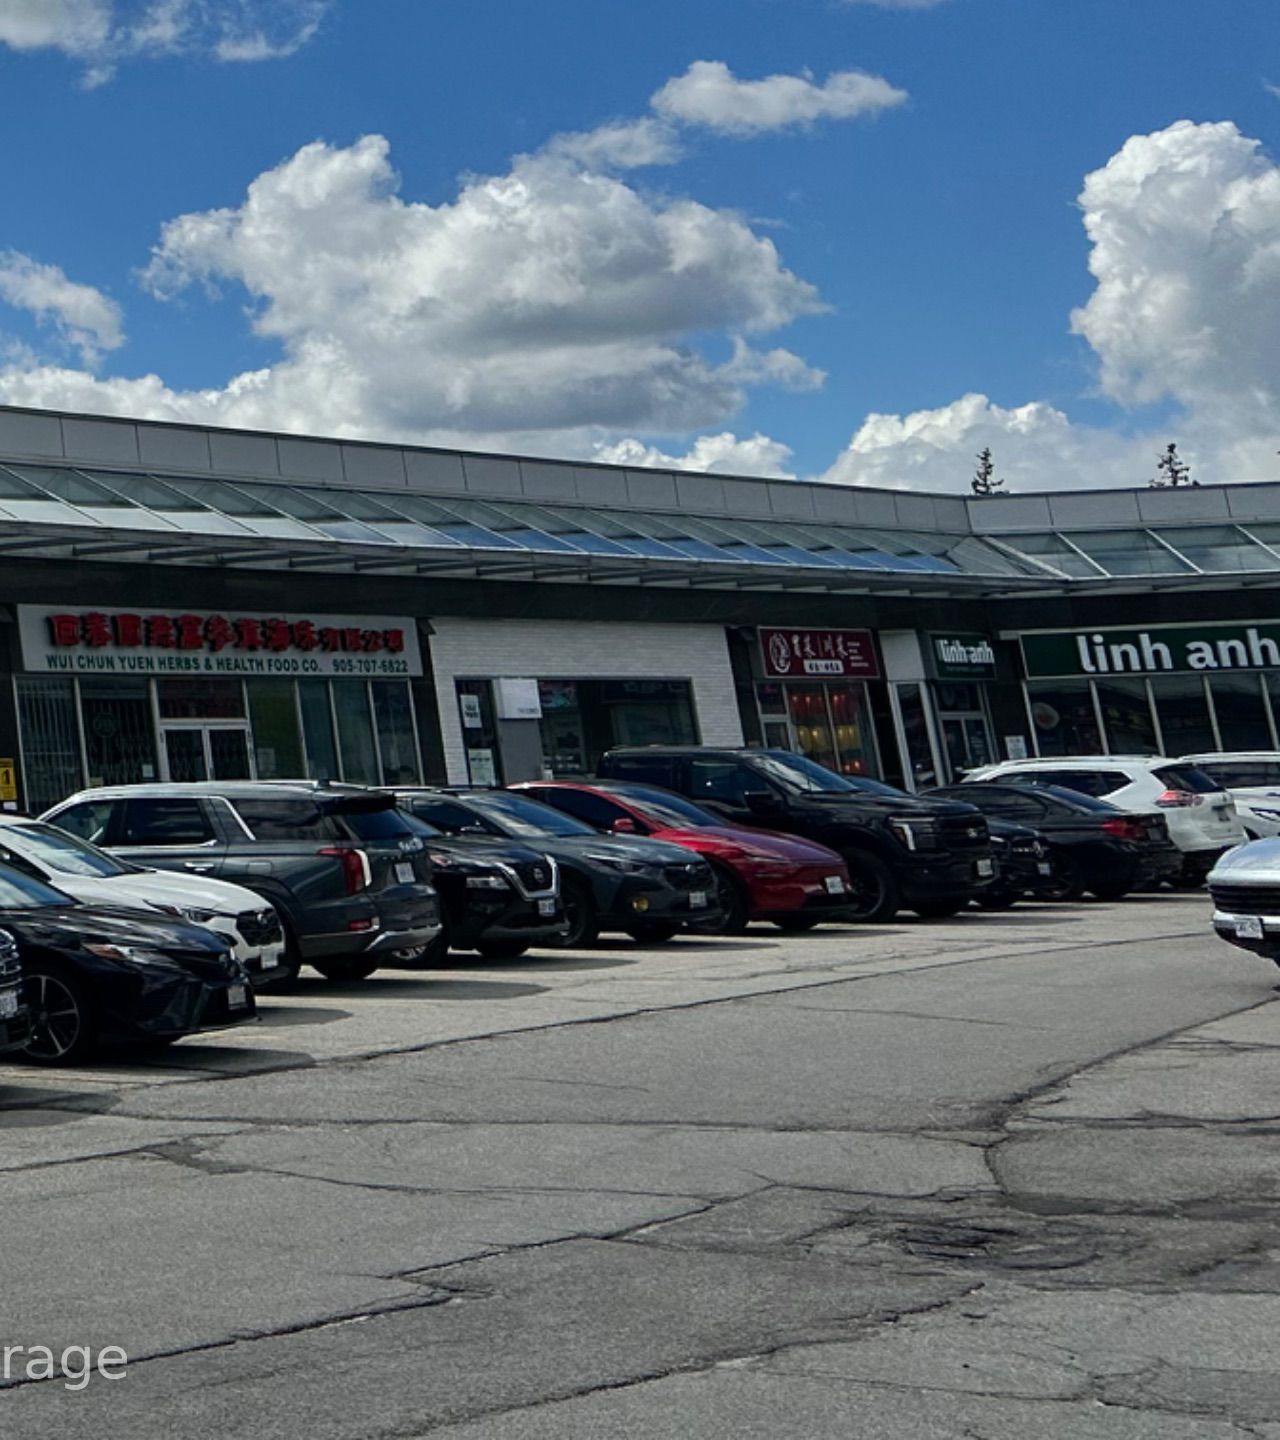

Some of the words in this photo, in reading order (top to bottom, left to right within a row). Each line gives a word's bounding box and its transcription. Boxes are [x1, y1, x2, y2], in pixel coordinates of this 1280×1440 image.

[45, 655, 73, 669] WUI
[79, 655, 116, 670] CHUN
[120, 656, 155, 671] YUEN
[158, 657, 200, 671] HERBS
[204, 658, 213, 671] &
[217, 658, 263, 672] HEALTH
[267, 659, 299, 672] FOOD
[1076, 633, 1174, 672] linh
[1185, 628, 1280, 670] anh
